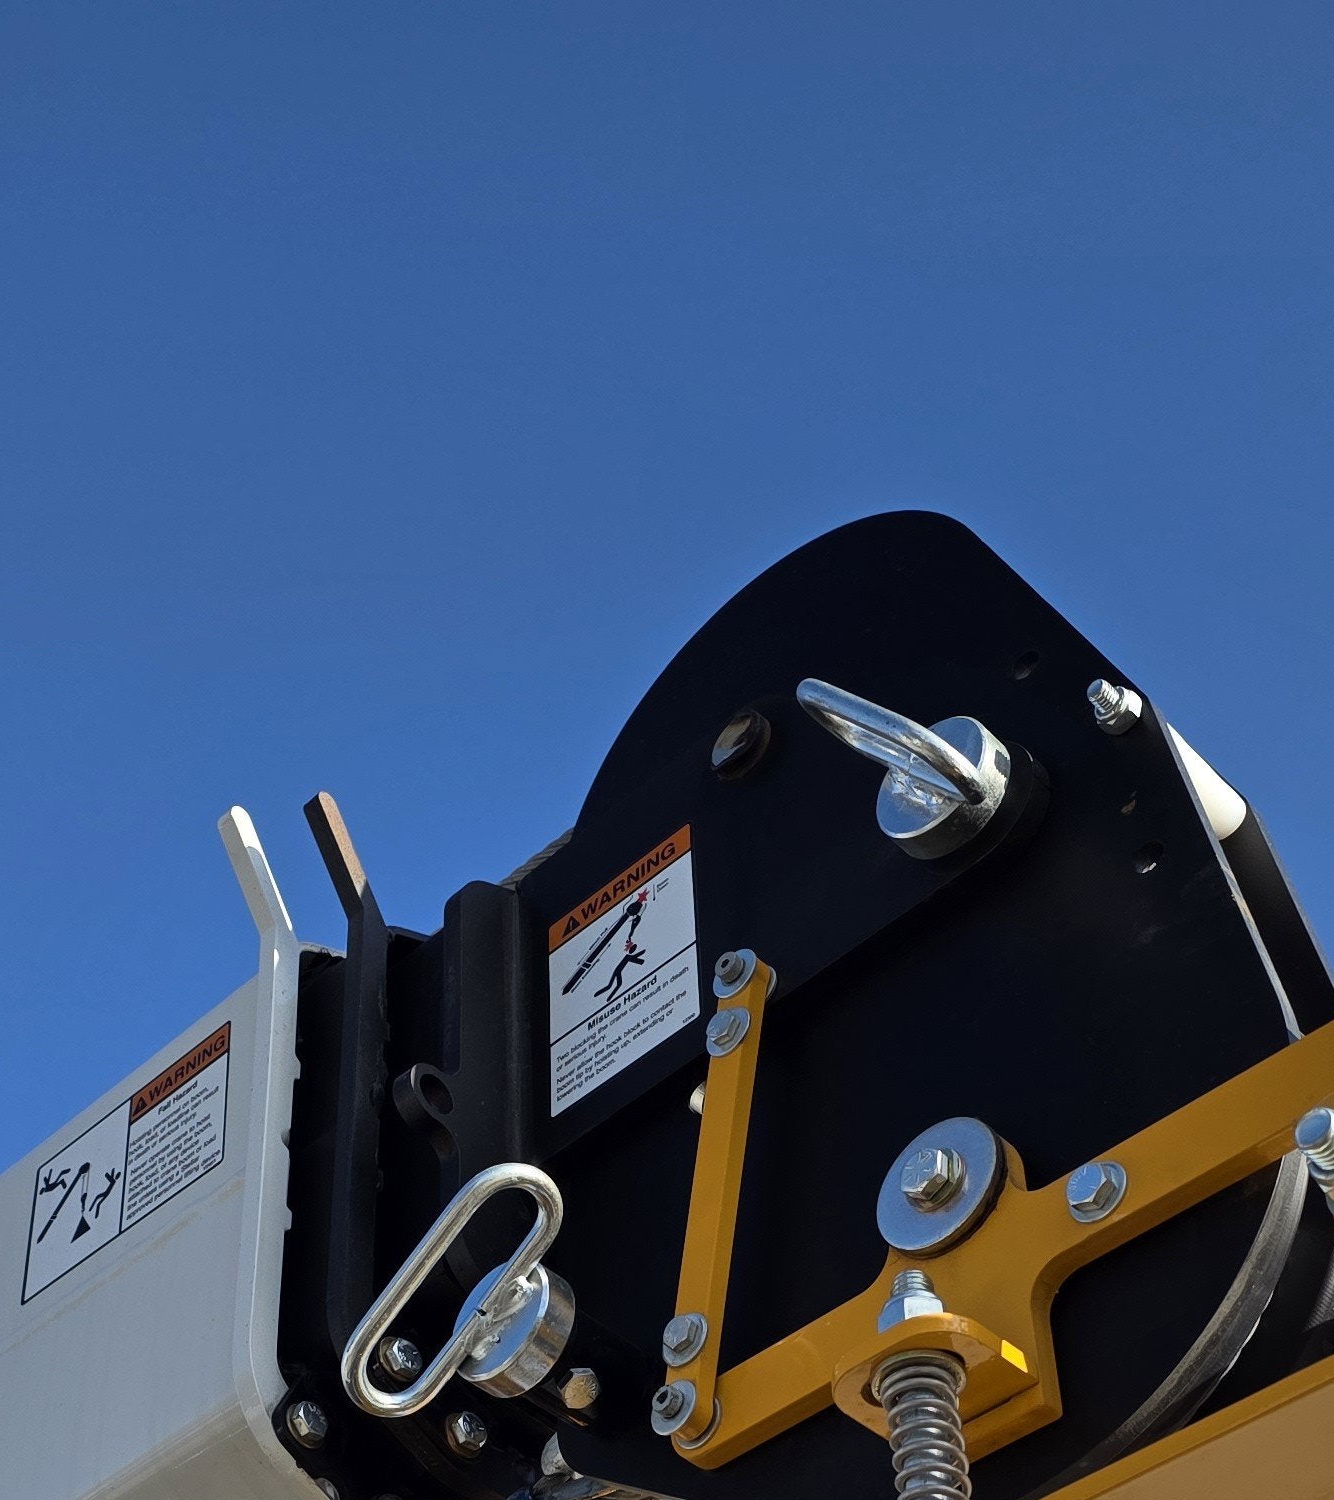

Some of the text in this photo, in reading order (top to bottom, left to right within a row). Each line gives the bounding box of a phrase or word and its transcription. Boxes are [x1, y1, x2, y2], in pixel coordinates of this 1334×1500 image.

[582, 840, 675, 922] WARNING
[557, 1049, 569, 1064] Two
[571, 1030, 596, 1055] blocking
[598, 1023, 608, 1035] the
[610, 1010, 627, 1027] crane
[629, 1000, 641, 1013] can
[643, 985, 661, 1003] result
[663, 980, 668, 989] in
[588, 1000, 621, 1031] Misuse
[624, 974, 657, 1006] Hazard
[557, 989, 686, 1085] Never allow the hook block to contact the
[557, 1076, 574, 1094] boom
[585, 1063, 593, 1076] by
[595, 1045, 619, 1069] hoisting
[633, 1014, 664, 1042] extending
[666, 1008, 673, 1017] or
[557, 1033, 606, 1073] or serious injury.
[148, 1033, 225, 1104] WARNING
[557, 1056, 616, 1104] lowering the boom.
[153, 1106, 181, 1132] personnel
[182, 1100, 189, 1110] on
[158, 1080, 197, 1116] Fall Hazard
[191, 1099, 201, 1111] can
[203, 1085, 219, 1102] result
[130, 1112, 210, 1176] Never operate crane to hoist
[130, 1160, 157, 1186] personnel
[184, 1134, 193, 1146] the
[180, 1138, 199, 1157] device
[201, 1149, 220, 1167] device
[204, 1134, 216, 1148] load
